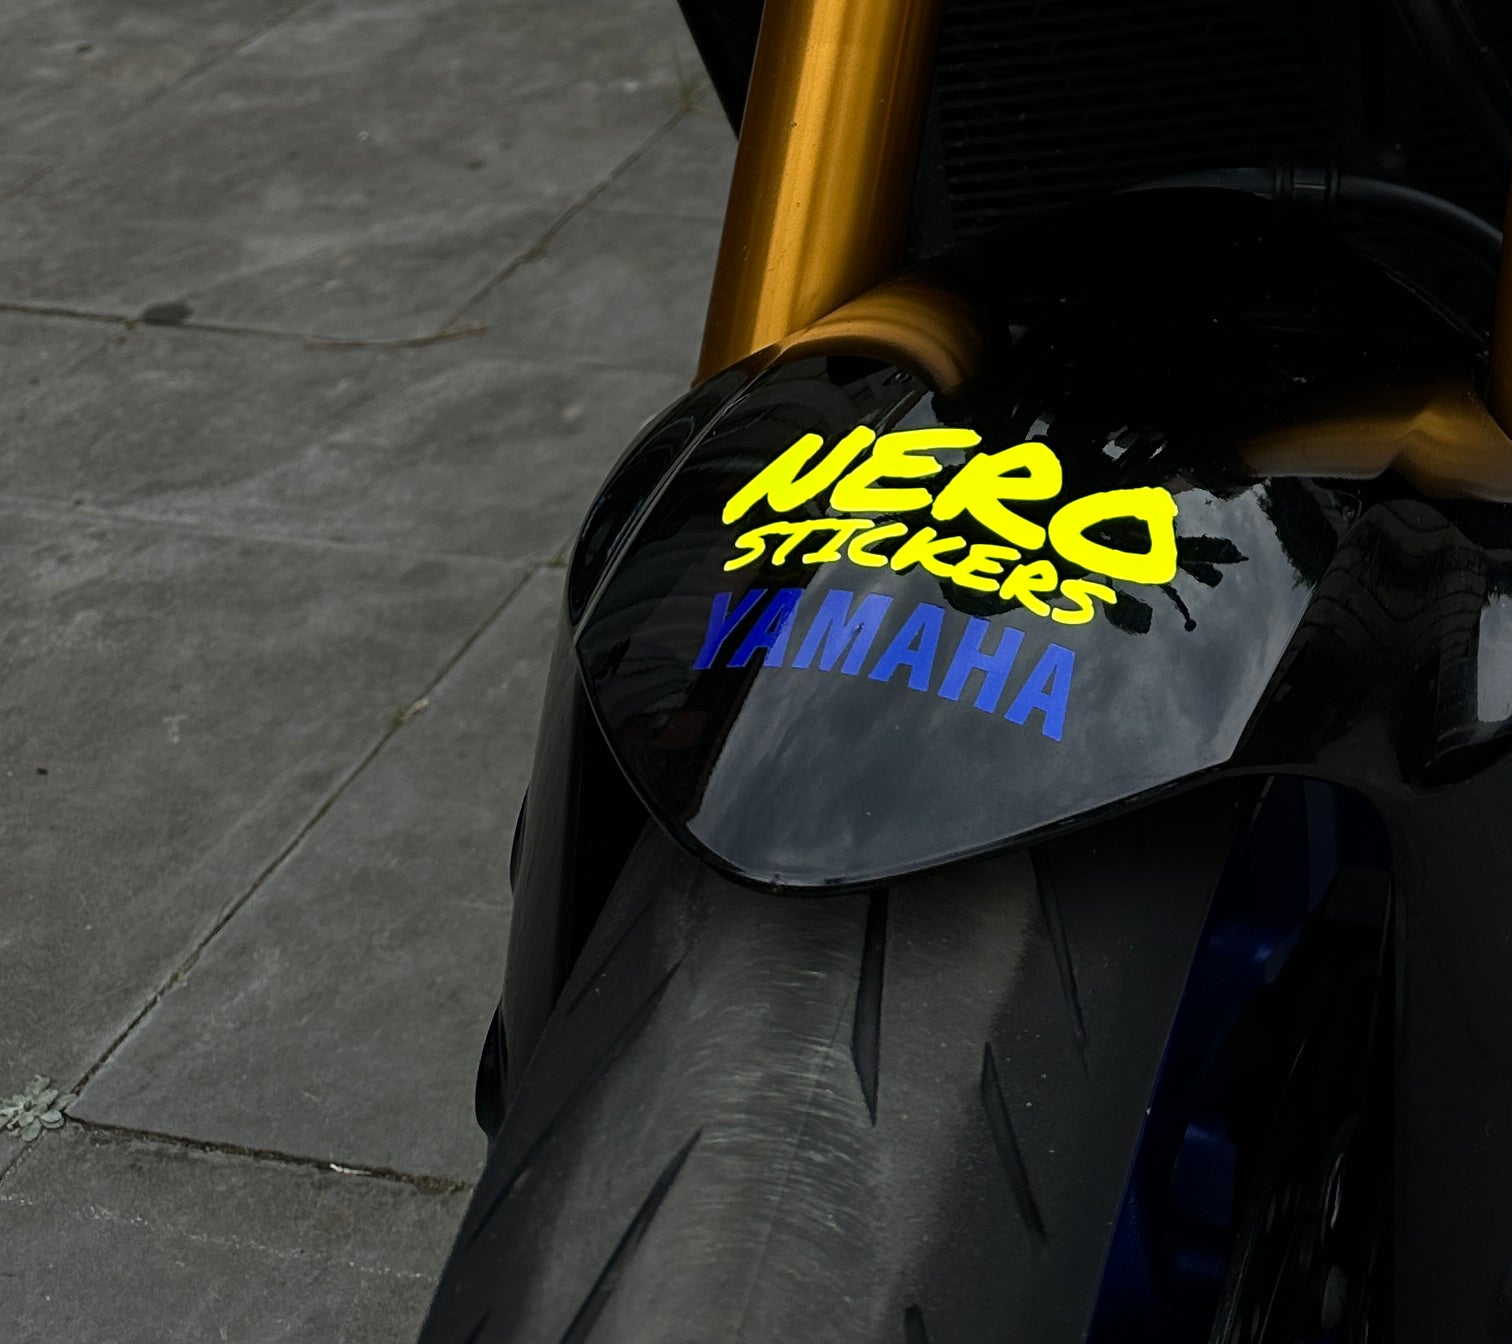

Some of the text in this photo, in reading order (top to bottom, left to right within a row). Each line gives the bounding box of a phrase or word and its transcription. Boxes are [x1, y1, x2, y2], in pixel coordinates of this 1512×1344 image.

[722, 425, 1178, 585] NERO
[724, 517, 1117, 625] STICKERS
[692, 587, 1076, 742] YAMAHA
